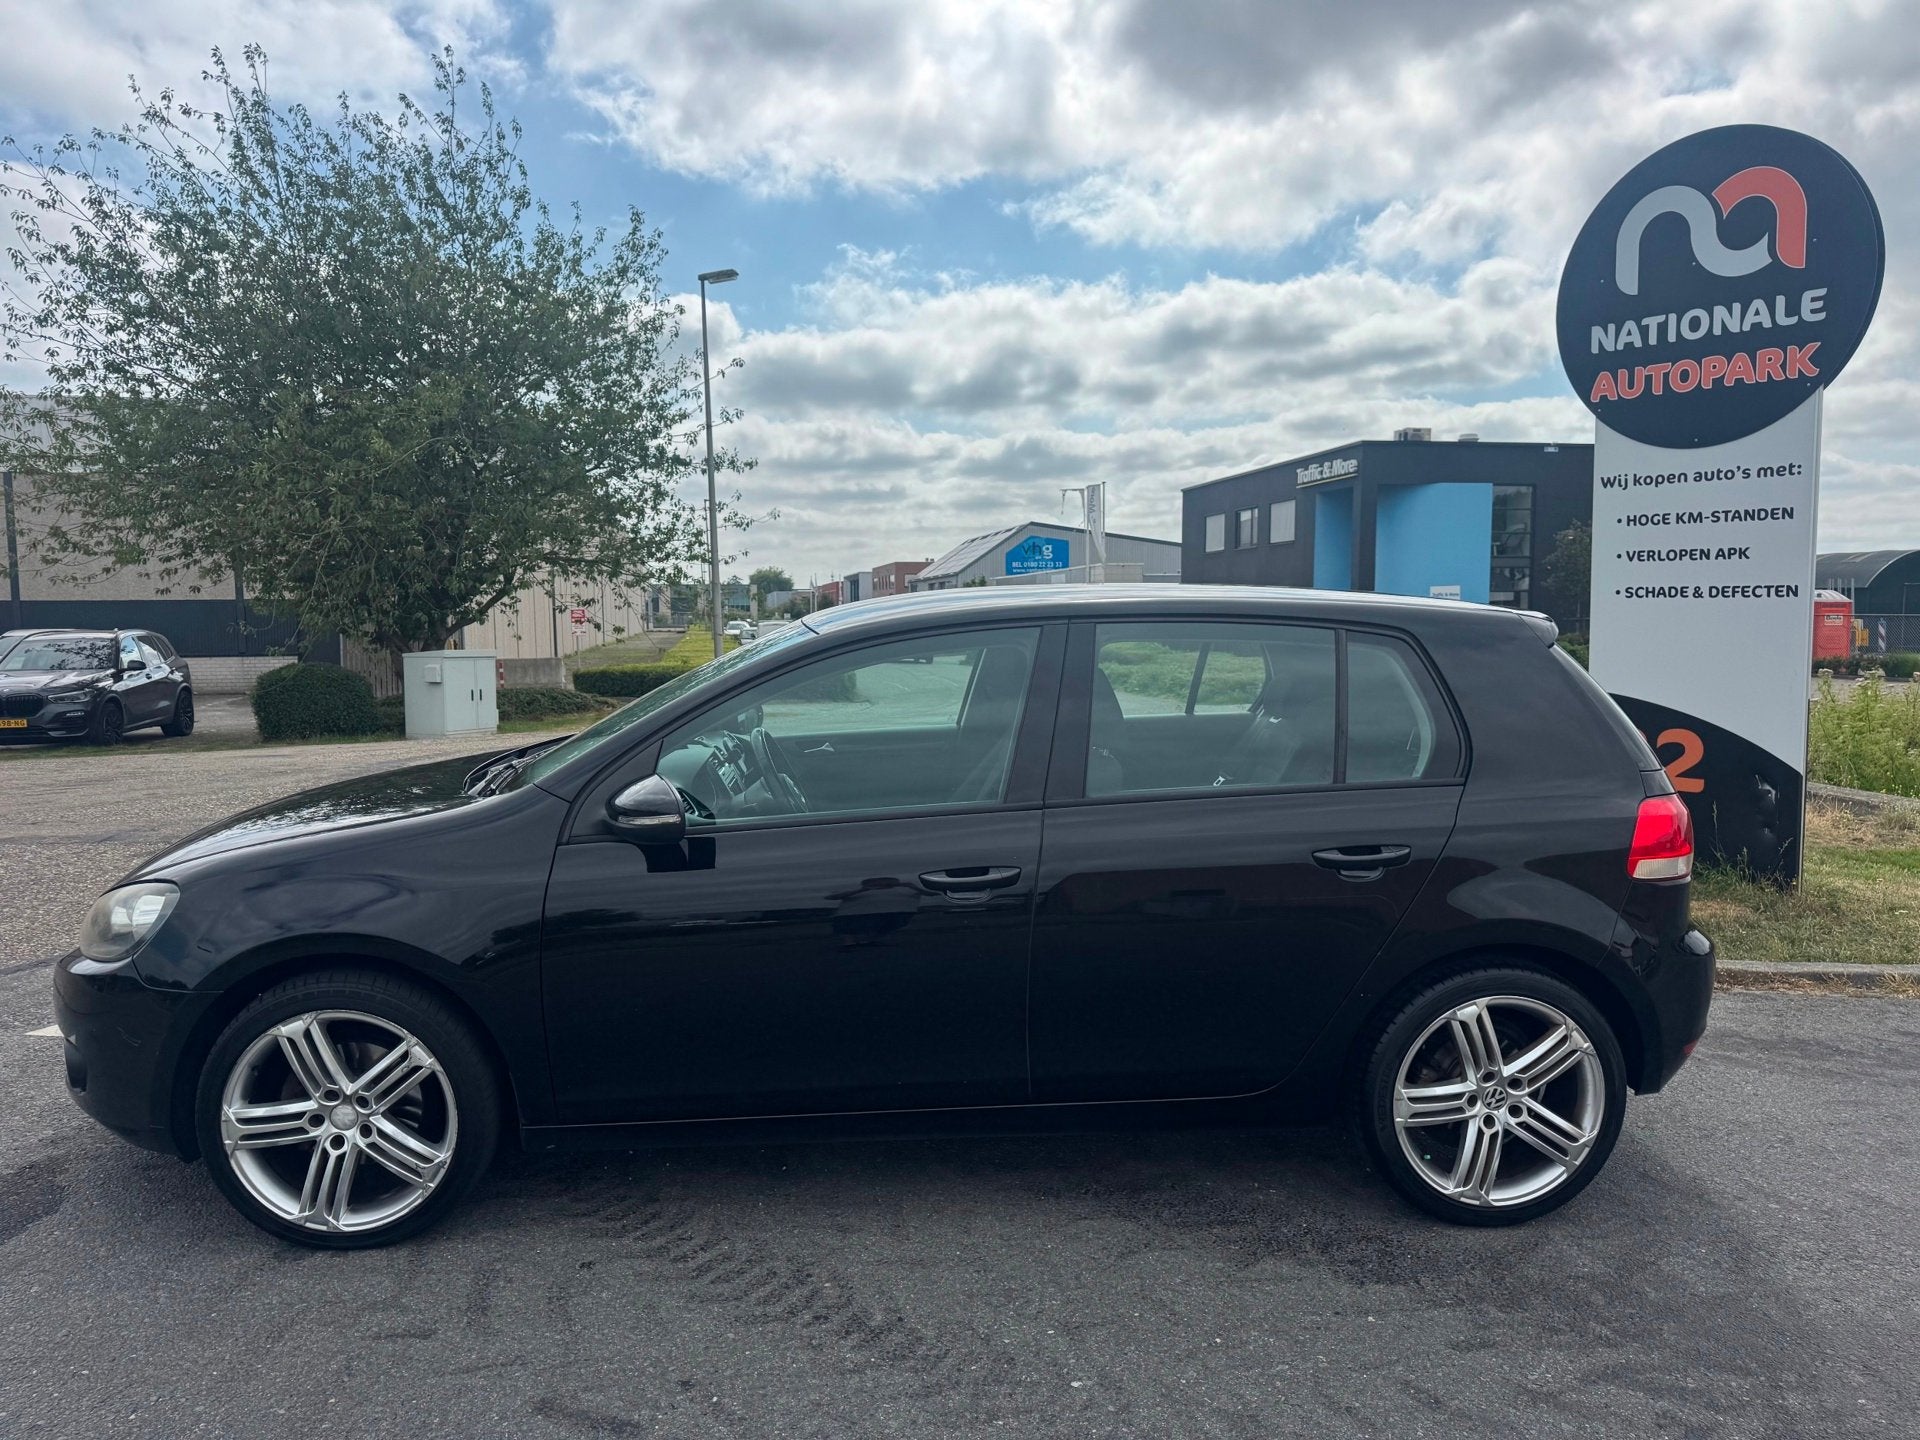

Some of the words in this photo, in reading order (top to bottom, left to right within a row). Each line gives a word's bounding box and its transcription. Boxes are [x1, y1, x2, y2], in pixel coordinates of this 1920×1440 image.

[1591, 287, 1828, 354] NATIONALE
[1590, 342, 1822, 403] AUTOPARK
[1296, 464, 1323, 484] Traffic
[1323, 462, 1332, 477] &
[1332, 459, 1358, 476] More
[1600, 474, 1629, 490] Wij
[1633, 472, 1688, 488] kopen
[1693, 466, 1751, 482] auto's
[1756, 462, 1803, 478] met:
[1626, 513, 1671, 526] HOGE
[1675, 507, 1795, 525] KM-STANDEN
[1022, 541, 1053, 559] vhg
[1626, 548, 1711, 562] VERLOPEN
[1714, 547, 1750, 560] APK
[1624, 586, 1689, 598] SCHADE
[1692, 586, 1704, 598] &
[1708, 585, 1799, 598] DEFECTEN
[1640, 728, 1705, 793] 2
